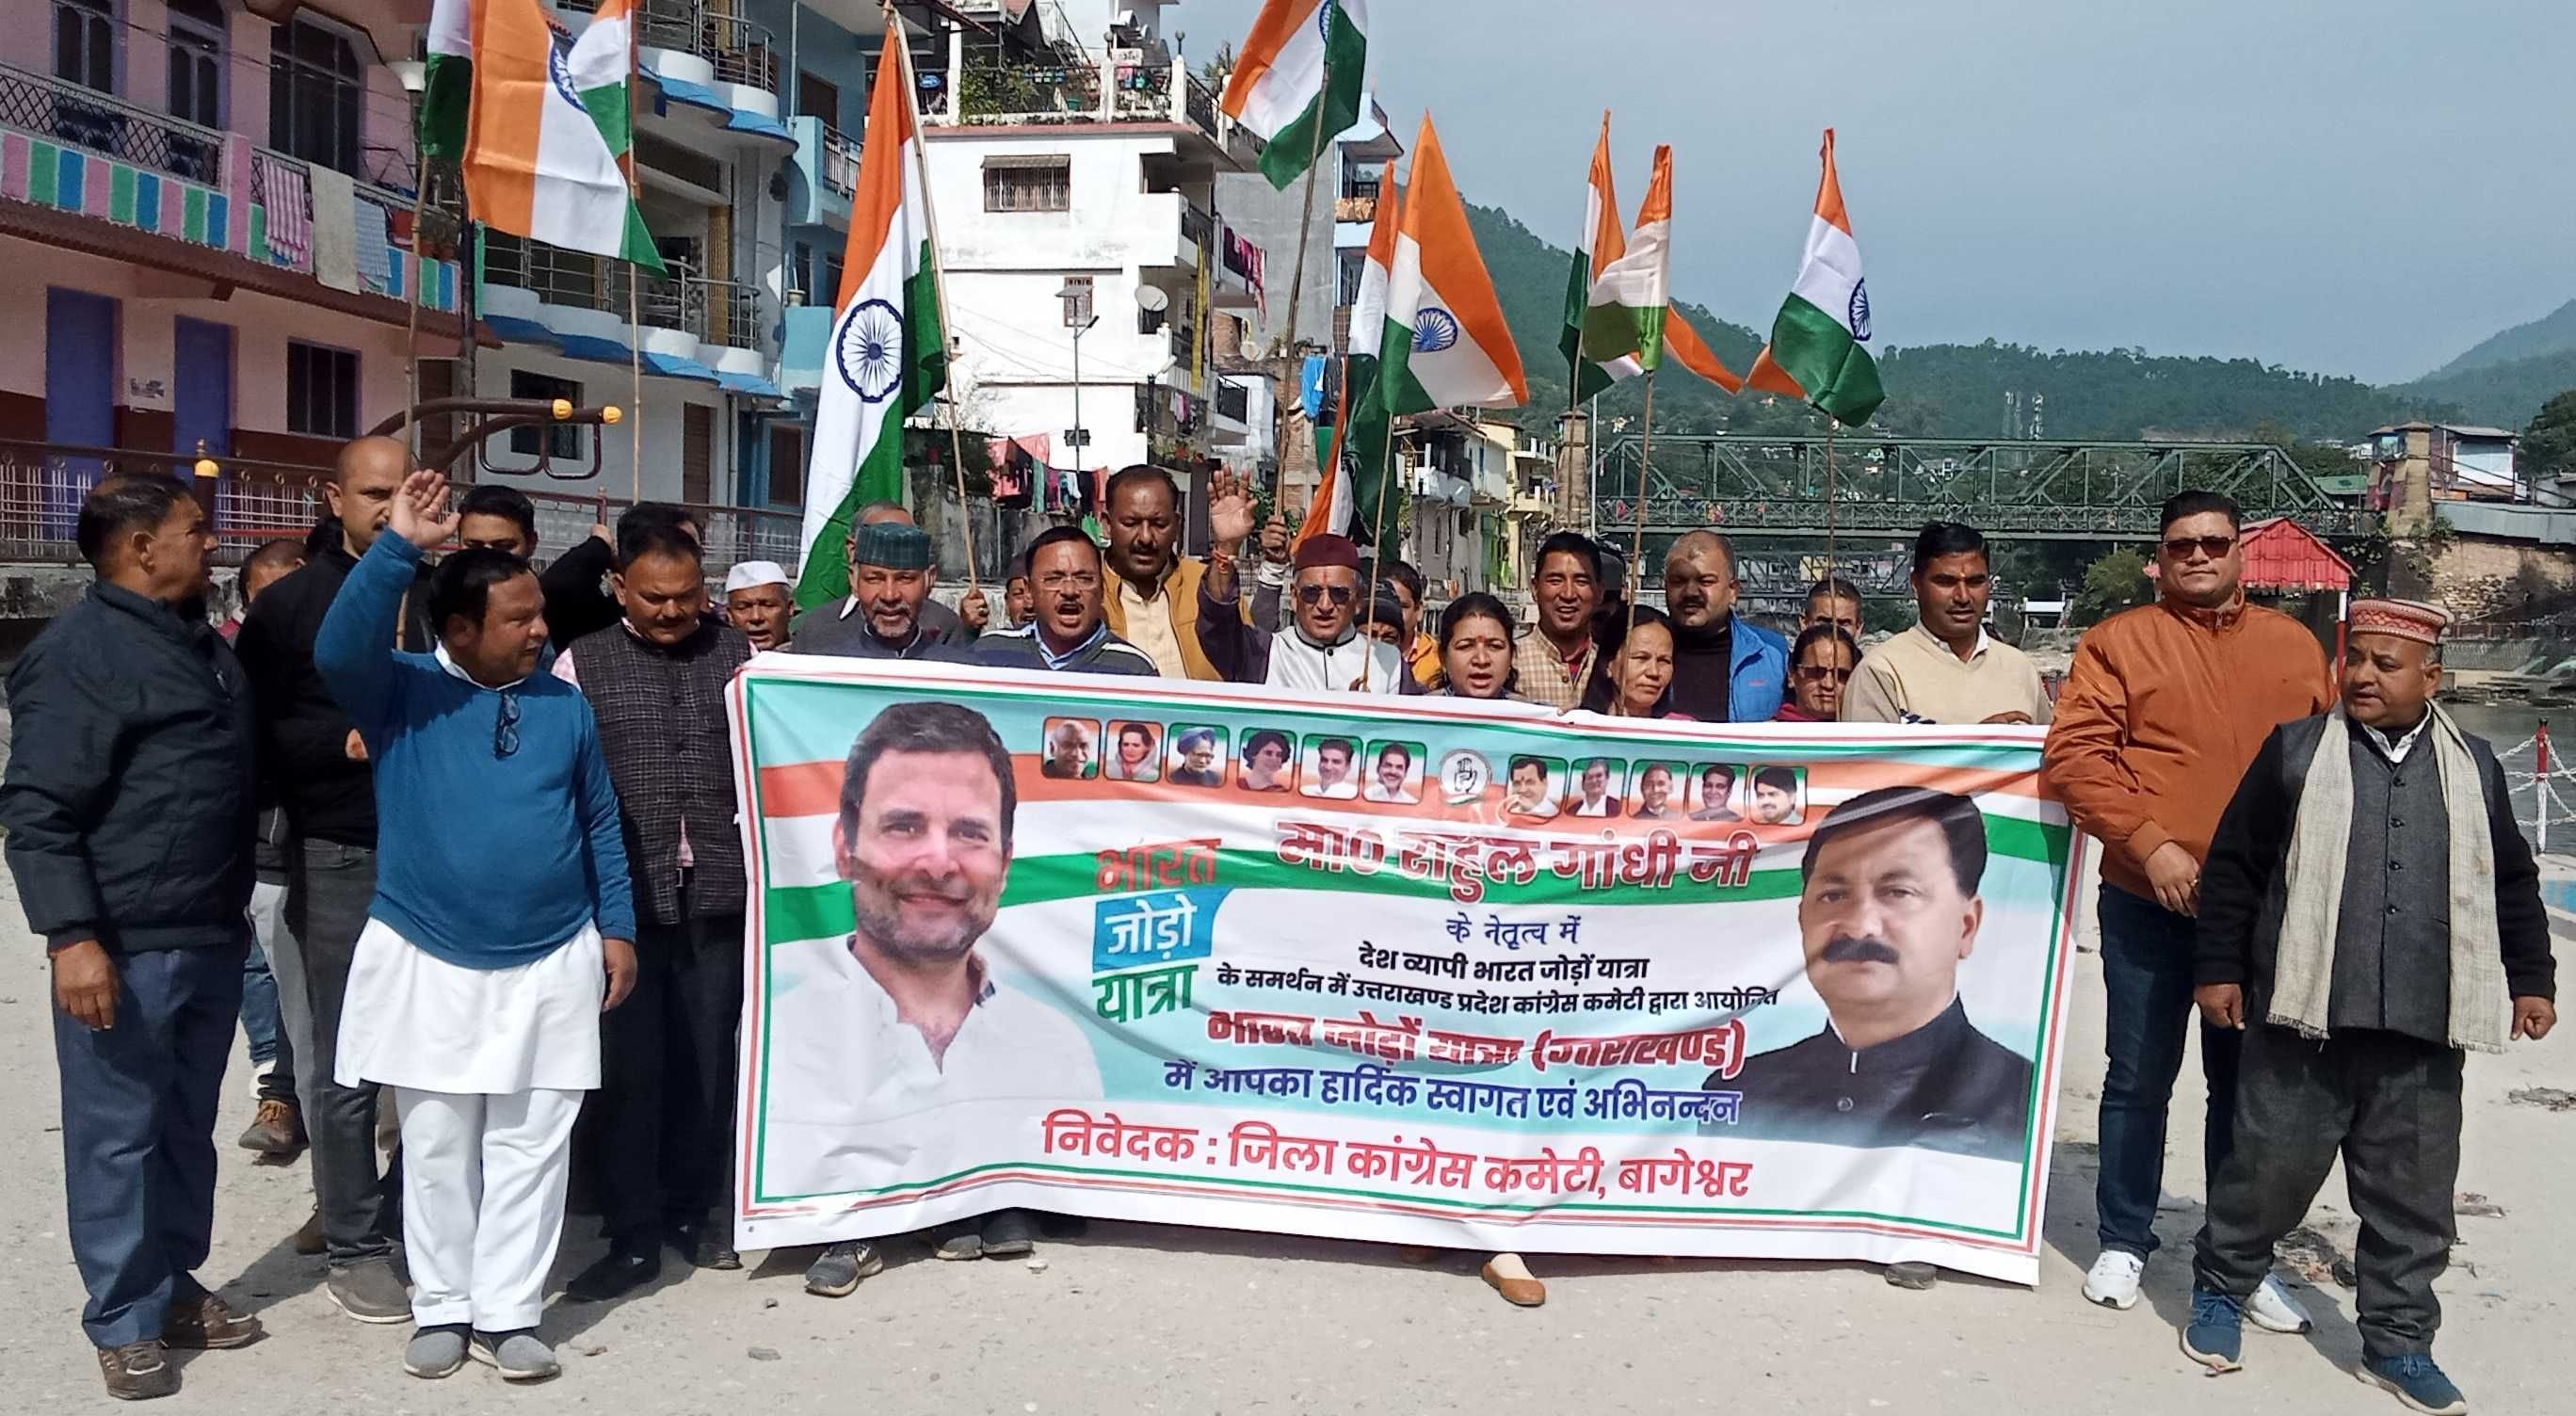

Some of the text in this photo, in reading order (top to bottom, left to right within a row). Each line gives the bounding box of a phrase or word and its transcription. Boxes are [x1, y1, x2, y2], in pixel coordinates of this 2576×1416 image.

[1095, 838, 1222, 893] भारत
[1277, 821, 1762, 904] मा० राहुल गांधी जी
[1104, 894, 1198, 960] जोड़ो
[1446, 911, 1582, 950] के नेतृत्व में
[1092, 964, 1199, 1022] यात्रा
[1217, 961, 1241, 986] के
[1245, 967, 1325, 993] समर्थन
[1328, 972, 1351, 996] में
[1352, 979, 1454, 1009] उत्तराखण्ड
[1458, 990, 1508, 1014] प्रदेश
[1513, 989, 1579, 1014] कांग्रेस
[1583, 987, 1645, 1011] कमेटी
[1649, 991, 1689, 1016] द्वारा
[1359, 941, 1650, 987] देश व्यापी भारत जोड़ों यात्रा
[1164, 1058, 1742, 1123] में आपका हार्दिक स्वागत एवं अभिनन्दन
[1041, 1108, 1199, 1163] निवेदक
[1228, 1120, 1339, 1176] जिला
[1345, 1134, 1477, 1189] कांग्रेस
[1485, 1147, 1605, 1199] कमेटी,
[1618, 1148, 1753, 1198] बागेश्वर
